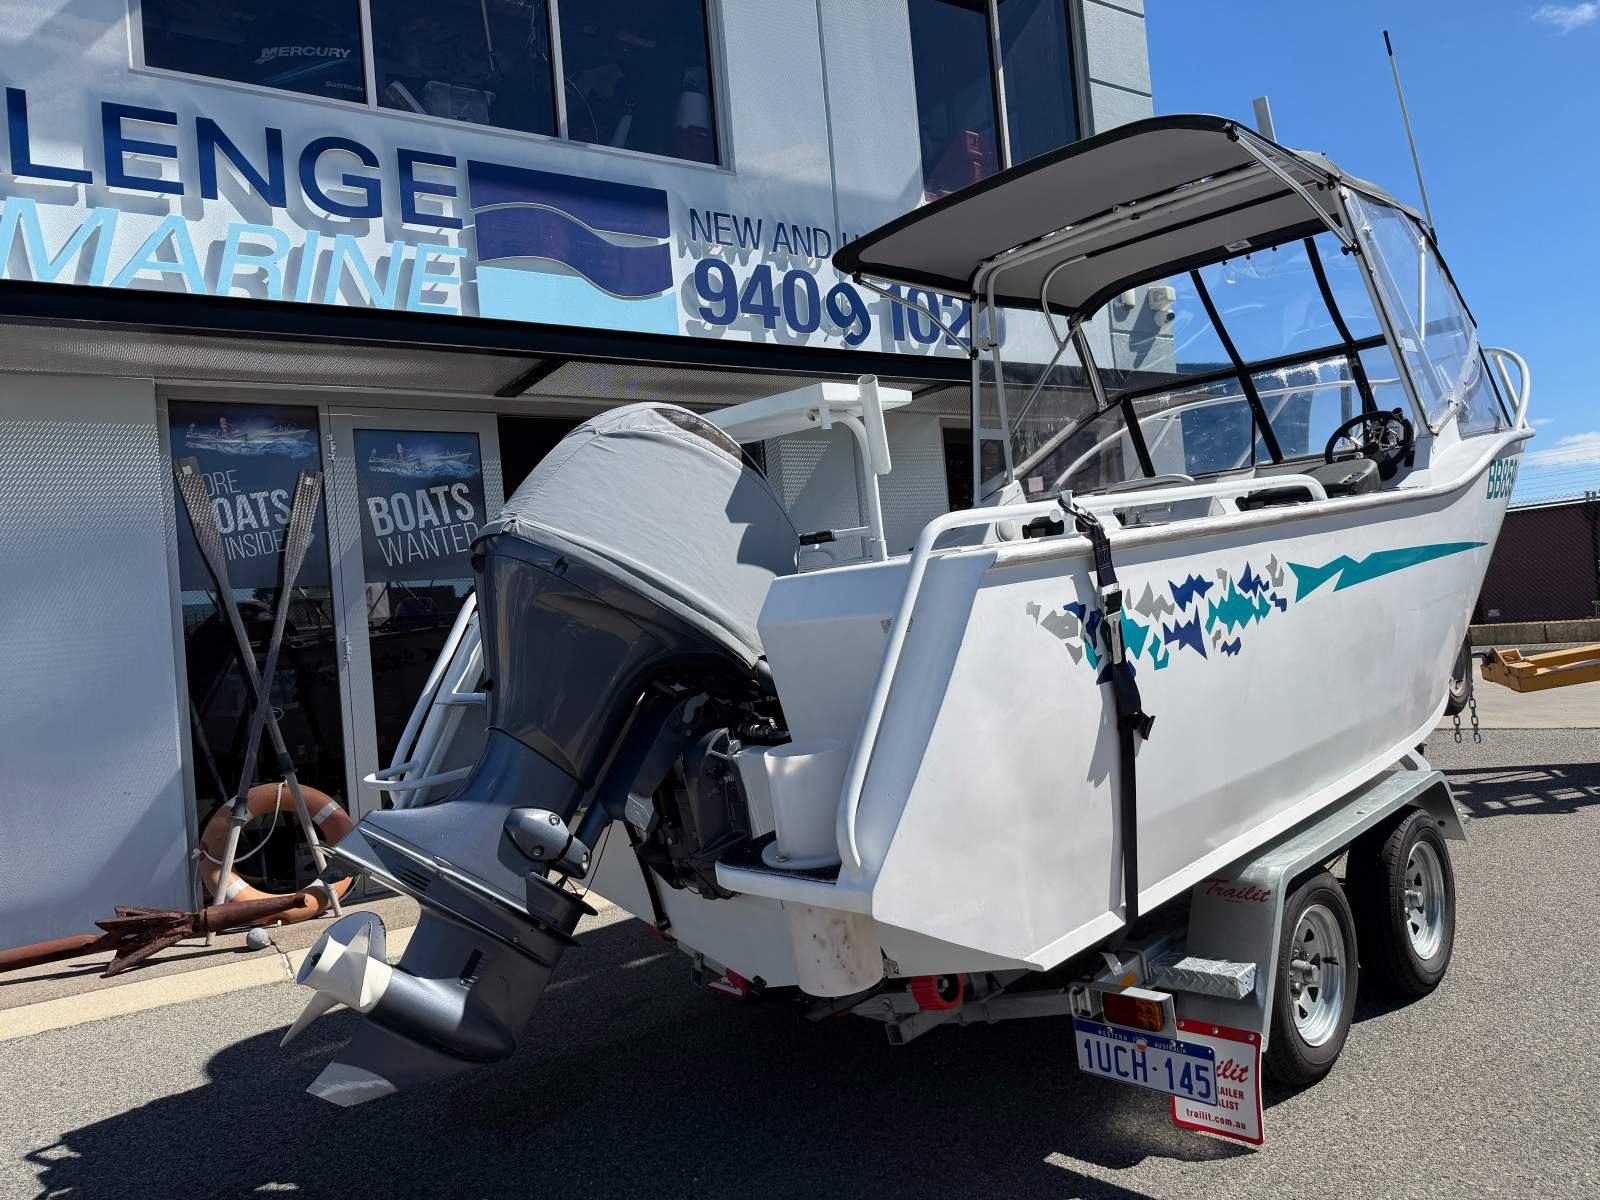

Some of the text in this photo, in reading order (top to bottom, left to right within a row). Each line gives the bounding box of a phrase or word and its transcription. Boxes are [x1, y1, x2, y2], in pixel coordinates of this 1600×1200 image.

[254, 46, 351, 64] MERCURY
[6, 87, 464, 230] LENGE
[0, 196, 467, 316] MARINE
[689, 207, 832, 260] NEW AND
[694, 258, 871, 346] 9409
[202, 469, 241, 497] ORE
[211, 488, 291, 534] OATS
[367, 482, 476, 538] BOATS
[224, 528, 286, 561] INSIDE
[377, 522, 479, 567] WANTED
[1200, 878, 1272, 902] Trailit
[1216, 1058, 1249, 1083] ilit
[1185, 1107, 1247, 1130] trailit.com.au
